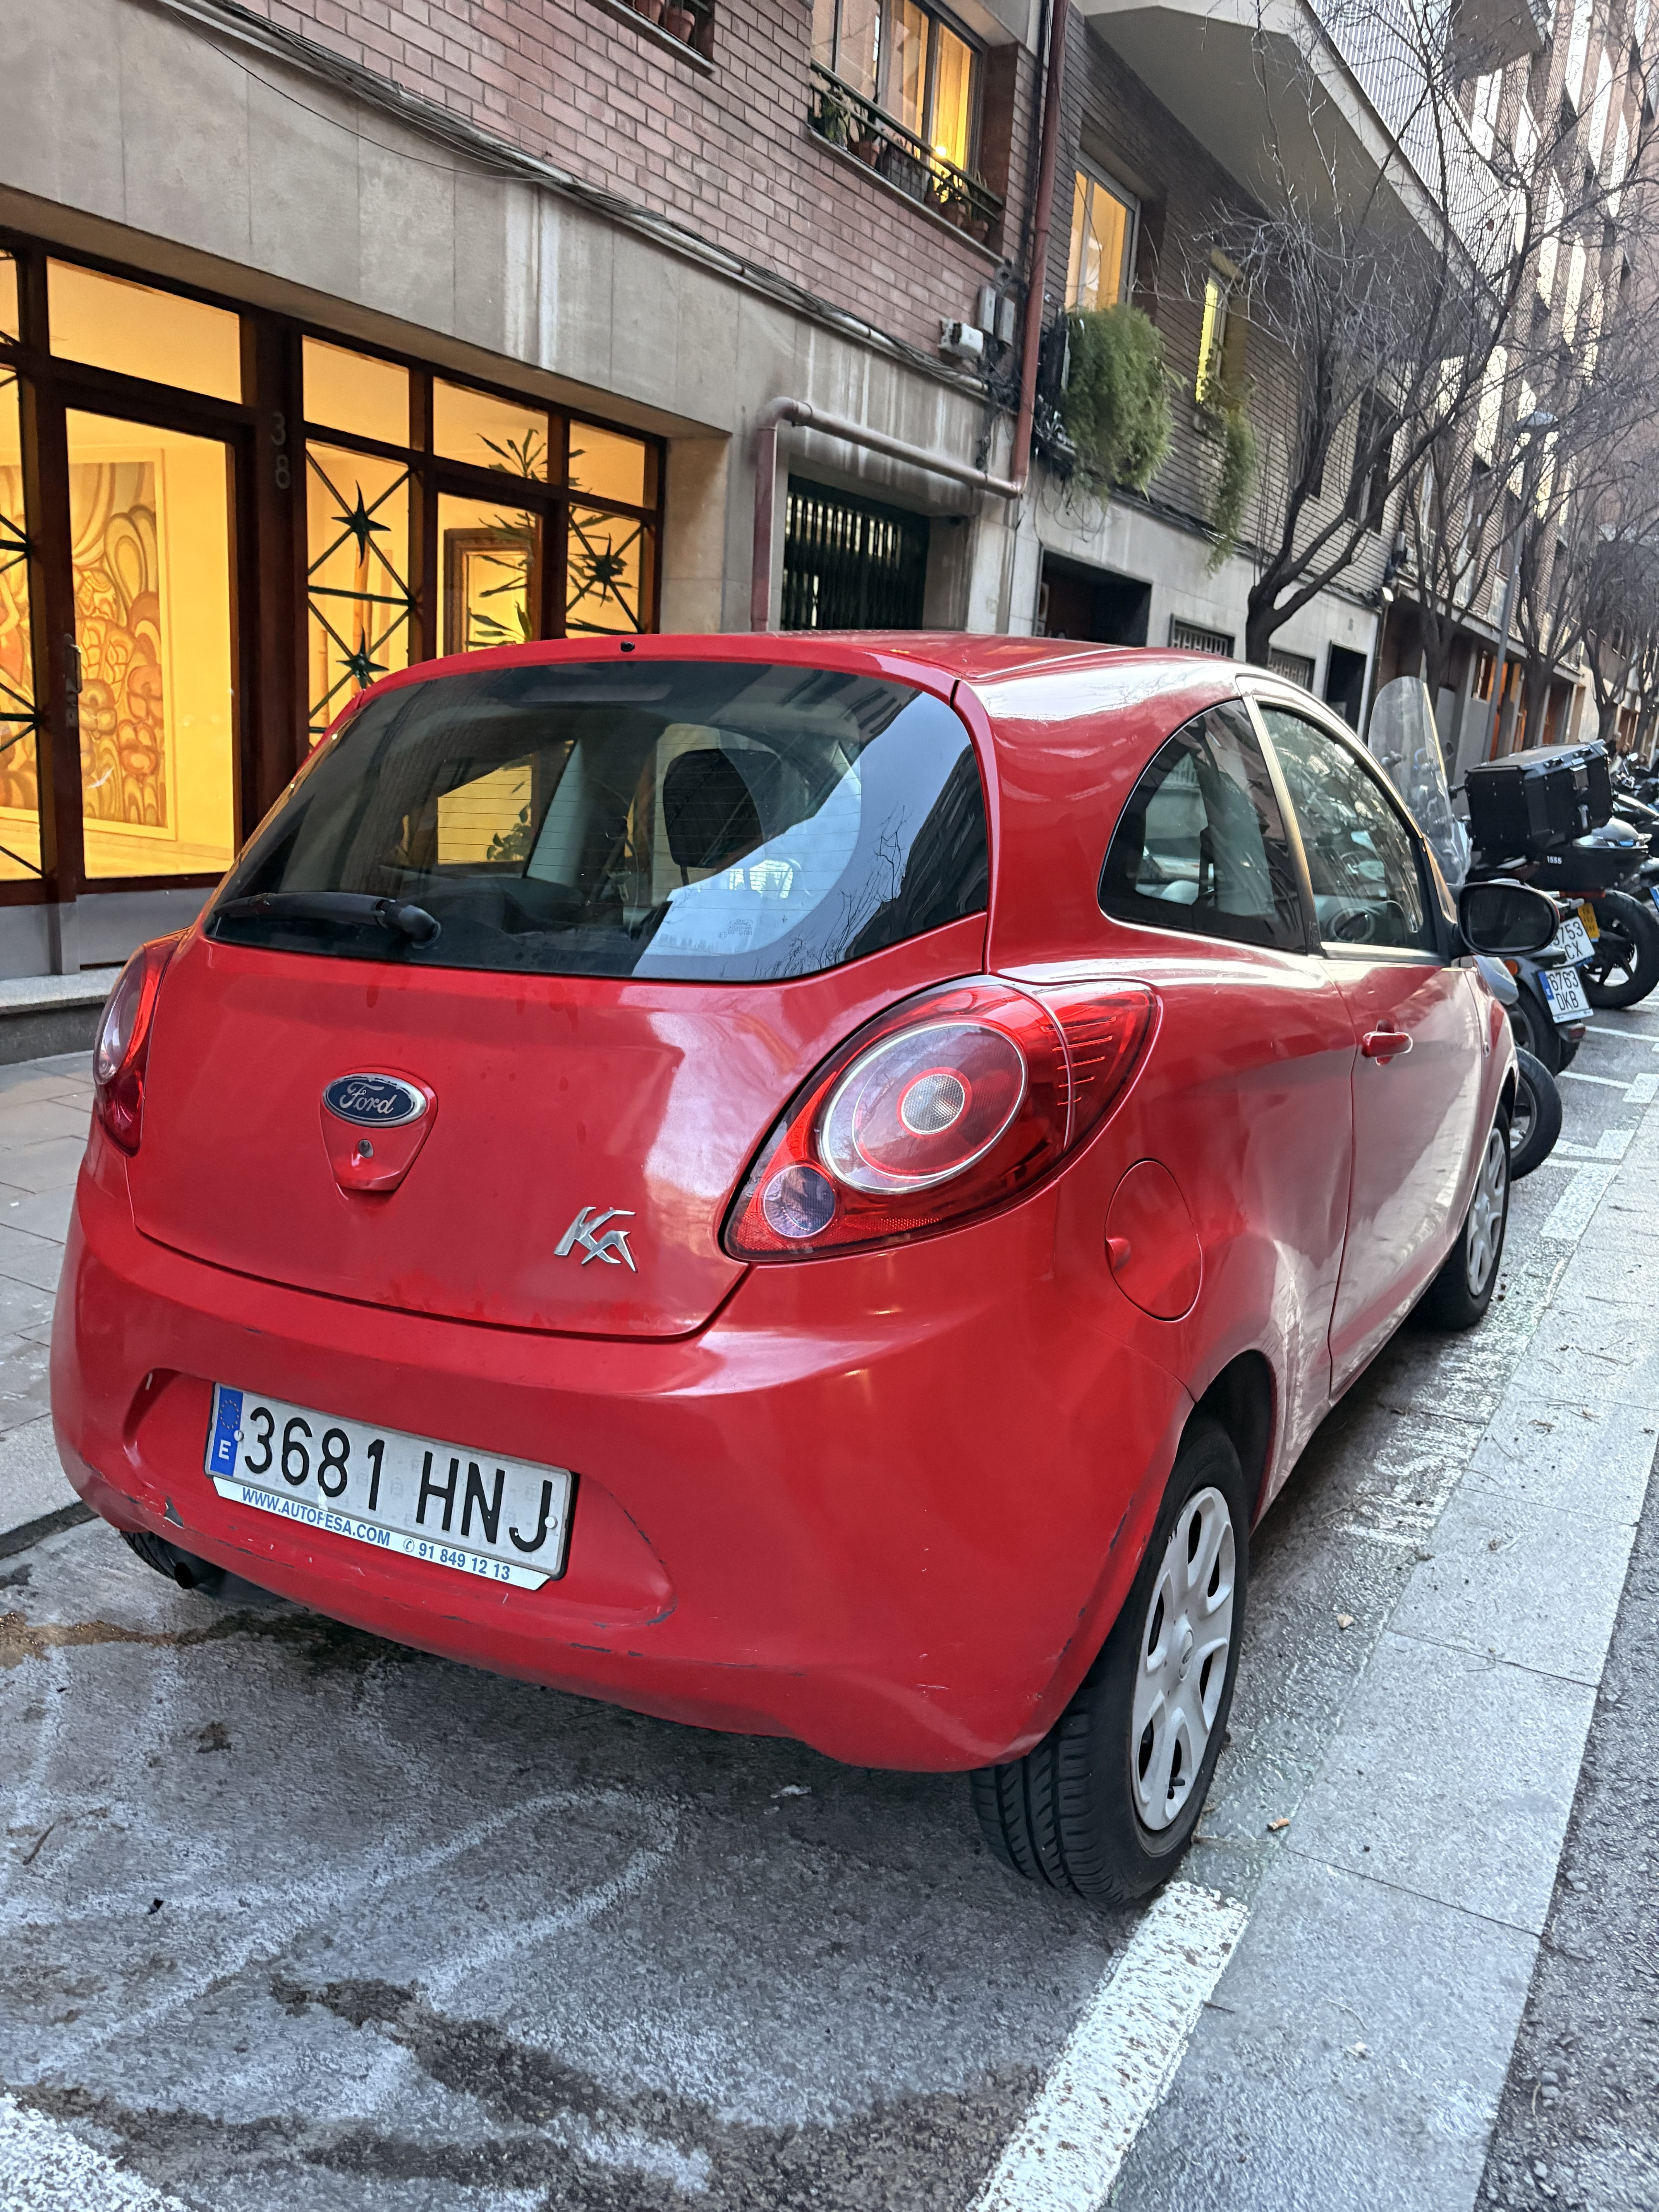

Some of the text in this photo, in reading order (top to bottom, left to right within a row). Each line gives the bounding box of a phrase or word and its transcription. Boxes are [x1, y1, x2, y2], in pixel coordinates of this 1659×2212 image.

[1549, 970, 1578, 991] 6763
[1556, 991, 1578, 1010] DKB
[339, 1082, 397, 1114] Ford
[554, 1206, 636, 1272] Ka
[218, 1440, 231, 1460] E
[244, 1407, 553, 1553] 3681 HNJ
[242, 1487, 511, 1580] WWW.AUTOFESA.COM 91 849 12 13
